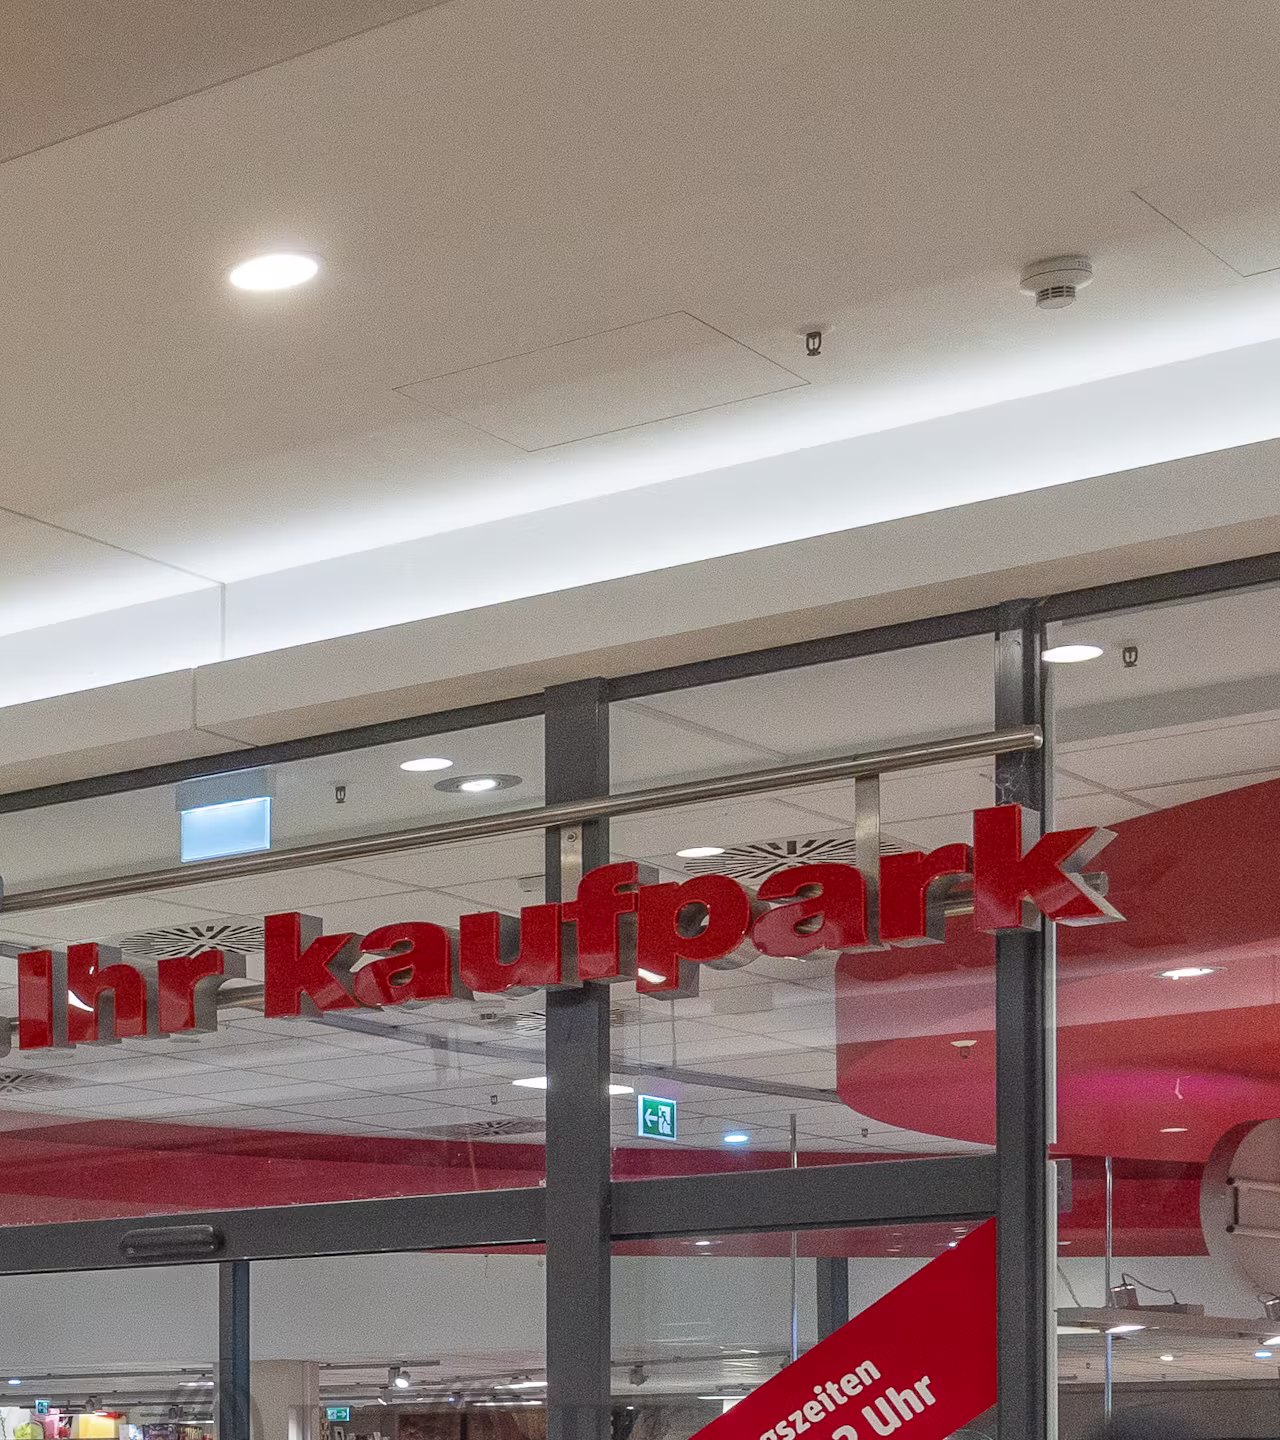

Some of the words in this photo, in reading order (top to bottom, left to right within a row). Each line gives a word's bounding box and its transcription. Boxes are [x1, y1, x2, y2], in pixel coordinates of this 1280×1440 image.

[18, 941, 230, 1052] Ihr
[264, 804, 1116, 1018] kaufpark
[861, 1375, 937, 1437] Uhr
